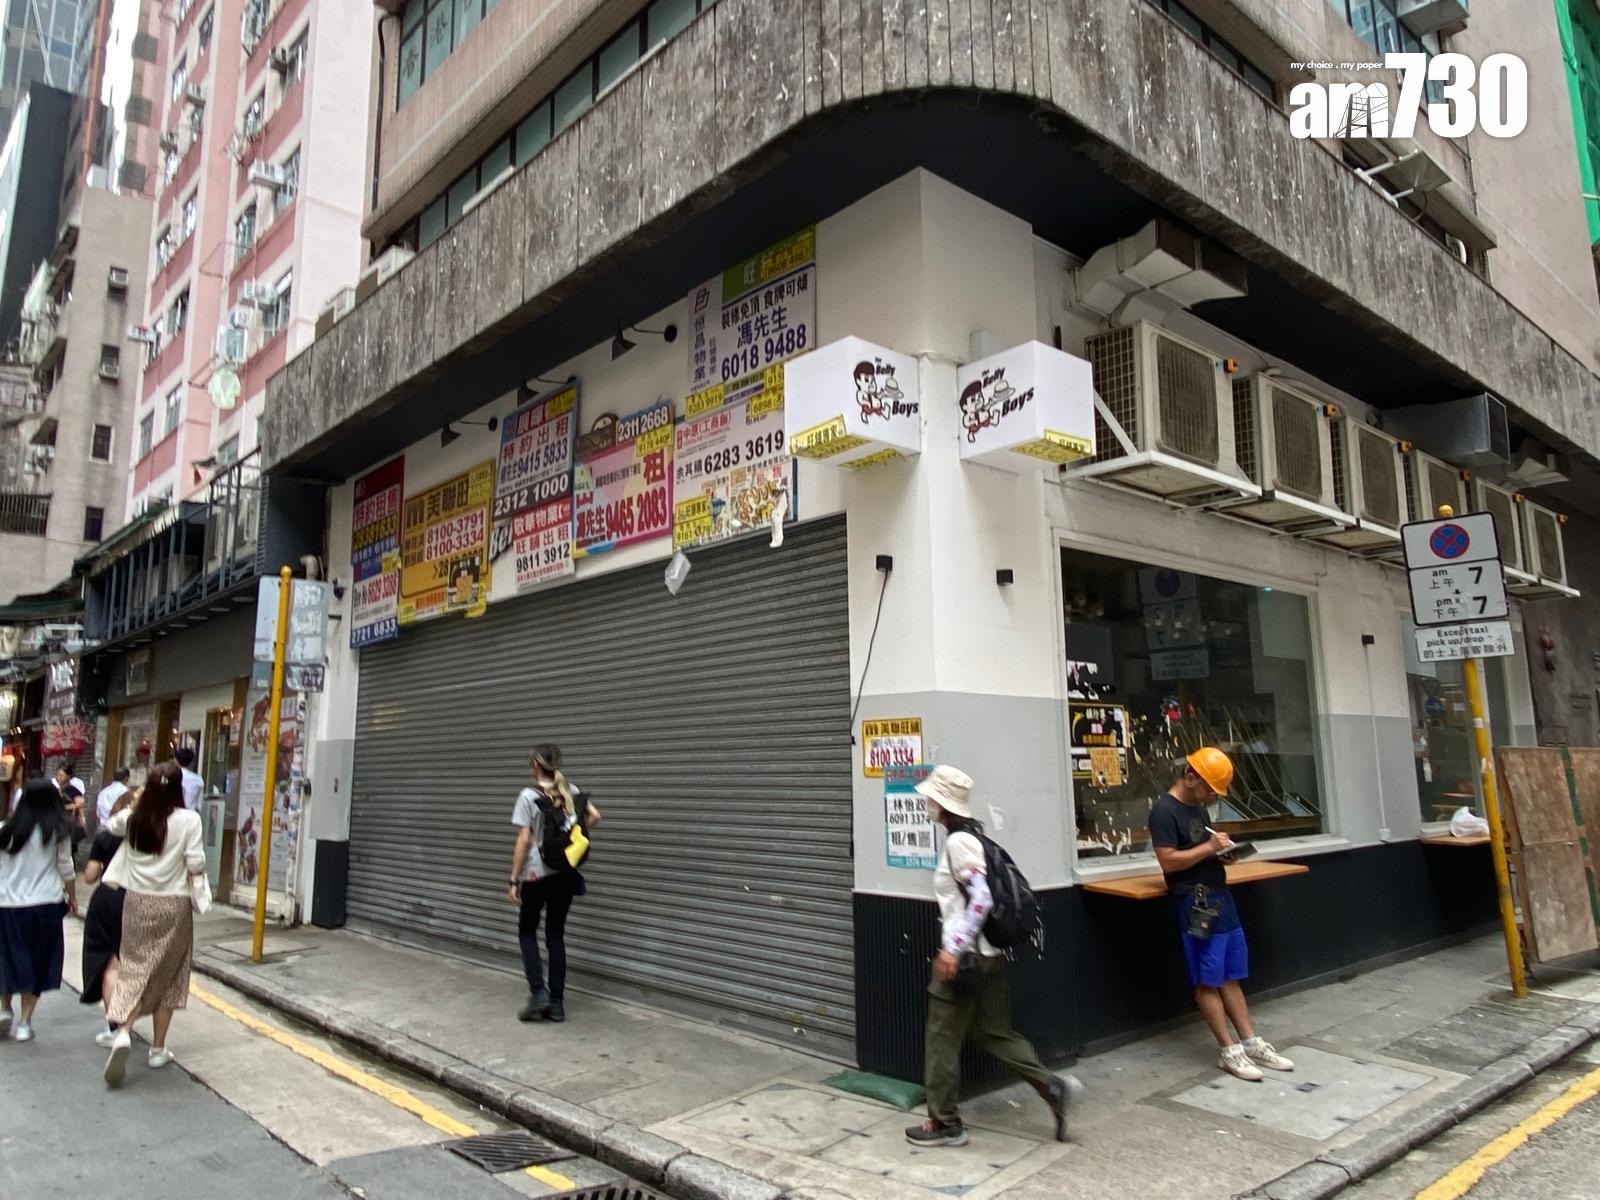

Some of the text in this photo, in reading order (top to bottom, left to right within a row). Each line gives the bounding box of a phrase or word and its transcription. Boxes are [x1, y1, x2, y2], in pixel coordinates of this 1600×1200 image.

[737, 306, 788, 349] 馮先生
[721, 324, 807, 382] 6018 9488
[876, 364, 896, 377] Belly
[982, 367, 1006, 389] Belly
[754, 398, 772, 412] 6898
[892, 399, 919, 420] Boys
[1001, 386, 1035, 418] Boys
[618, 419, 639, 442] 2311
[641, 406, 668, 432] 2668
[518, 450, 541, 478] 9415
[543, 438, 567, 467] 5833
[704, 445, 740, 474] 6283
[745, 430, 784, 462] 3619
[643, 448, 666, 486] 租
[493, 489, 528, 517] 2312
[533, 474, 569, 502] 1000
[605, 497, 634, 541] 9465
[637, 486, 667, 532] 2083
[427, 509, 484, 545] 8100-3791
[427, 528, 484, 561] 8100-3334
[516, 553, 540, 573] 9811
[544, 542, 570, 565] 3912
[1429, 578, 1455, 590] 上午
[1432, 566, 1483, 585] am 7
[1433, 608, 1459, 619] 下午
[1436, 596, 1487, 615] pm 7
[351, 619, 396, 644] 2721 6833
[1427, 636, 1484, 647] pick up/drop
[1470, 626, 1488, 634] taxi
[1423, 644, 1507, 659] 的士上落客除外
[870, 746, 914, 768] 8100 3334
[889, 813, 908, 825] 6091
